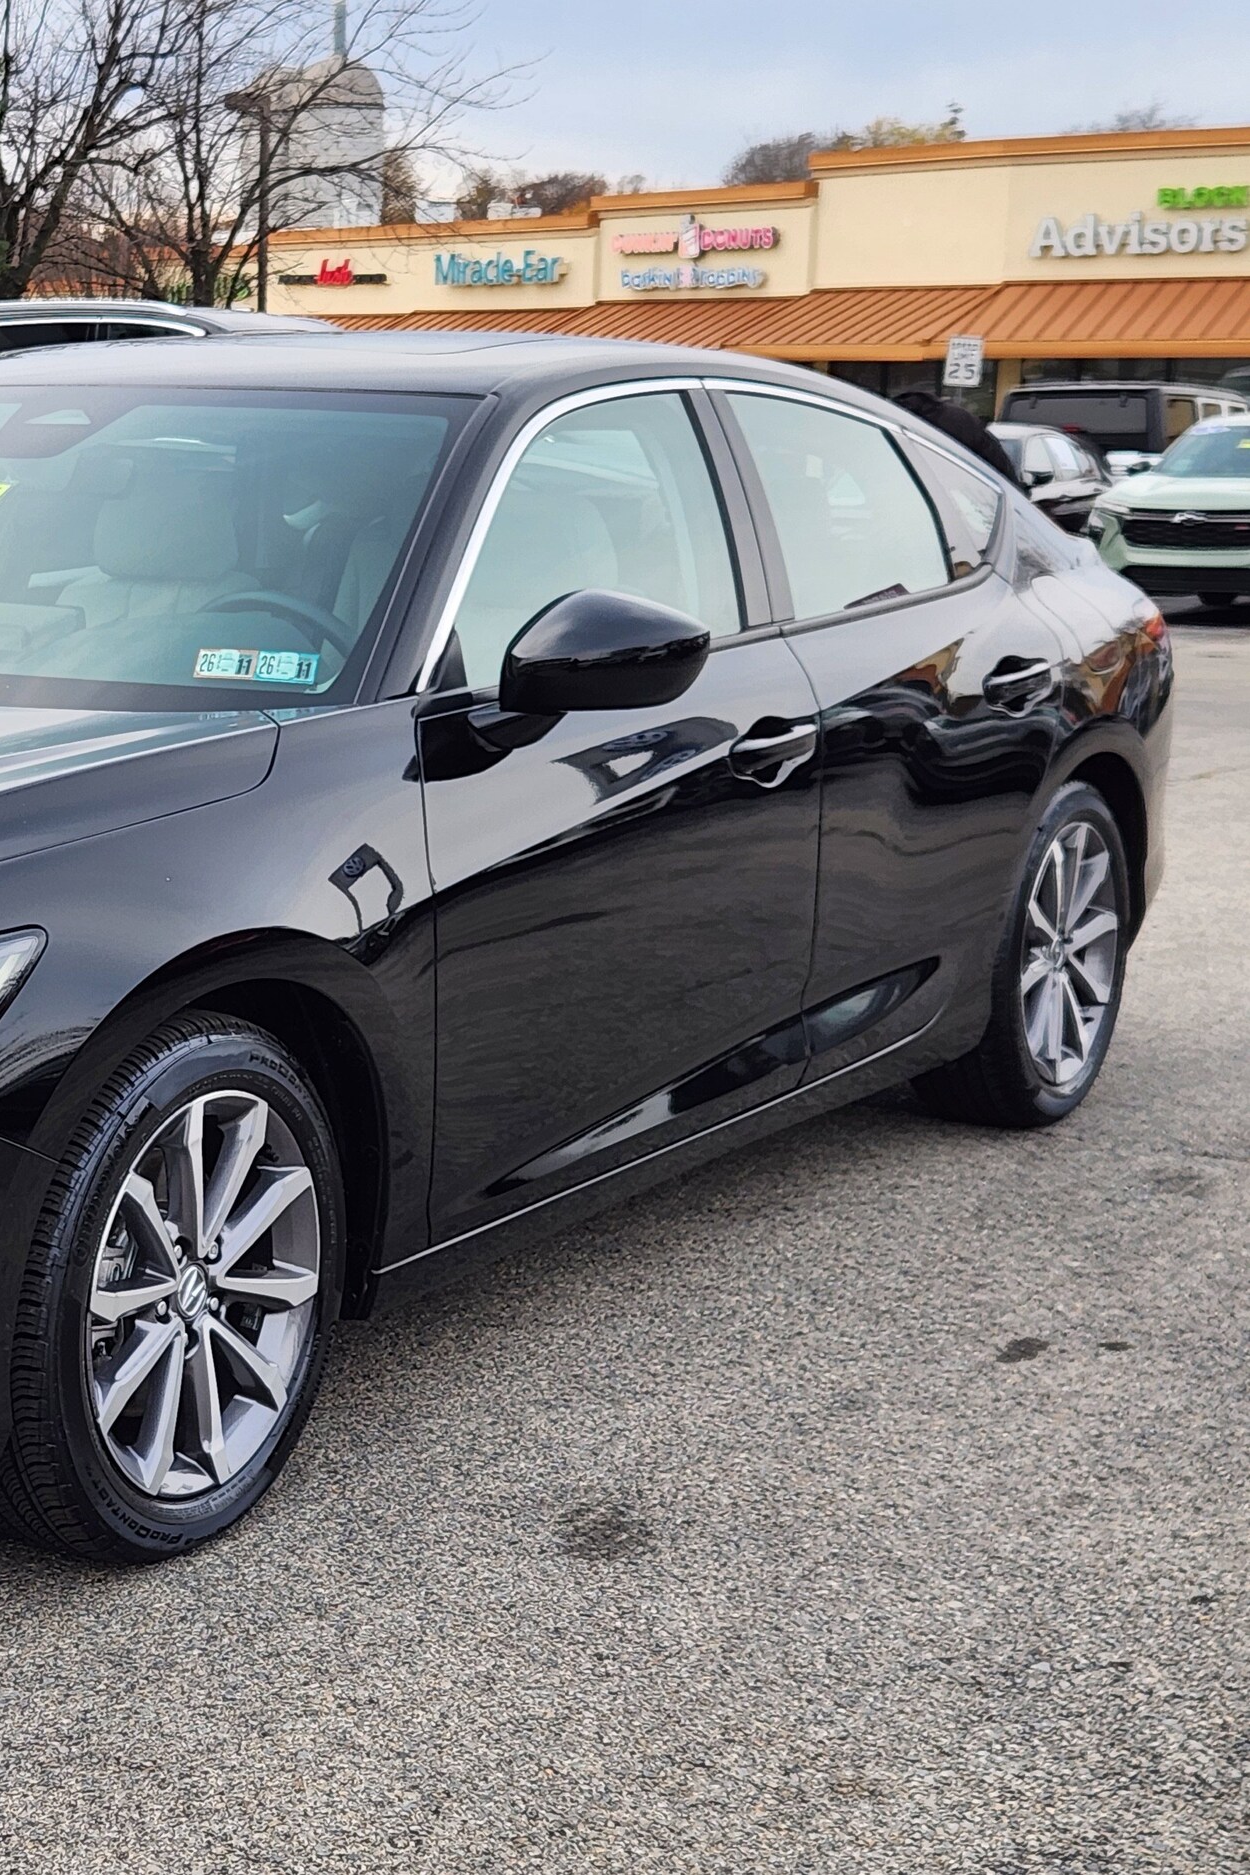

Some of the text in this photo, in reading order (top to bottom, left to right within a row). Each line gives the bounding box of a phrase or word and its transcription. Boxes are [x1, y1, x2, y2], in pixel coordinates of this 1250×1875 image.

[1029, 211, 1248, 258] Advisors
[434, 250, 561, 286] Miracle-Ear
[948, 362, 977, 380] 25
[200, 653, 216, 672] 26
[236, 658, 253, 675] 11
[259, 655, 276, 675] 26
[297, 661, 312, 679] 11
